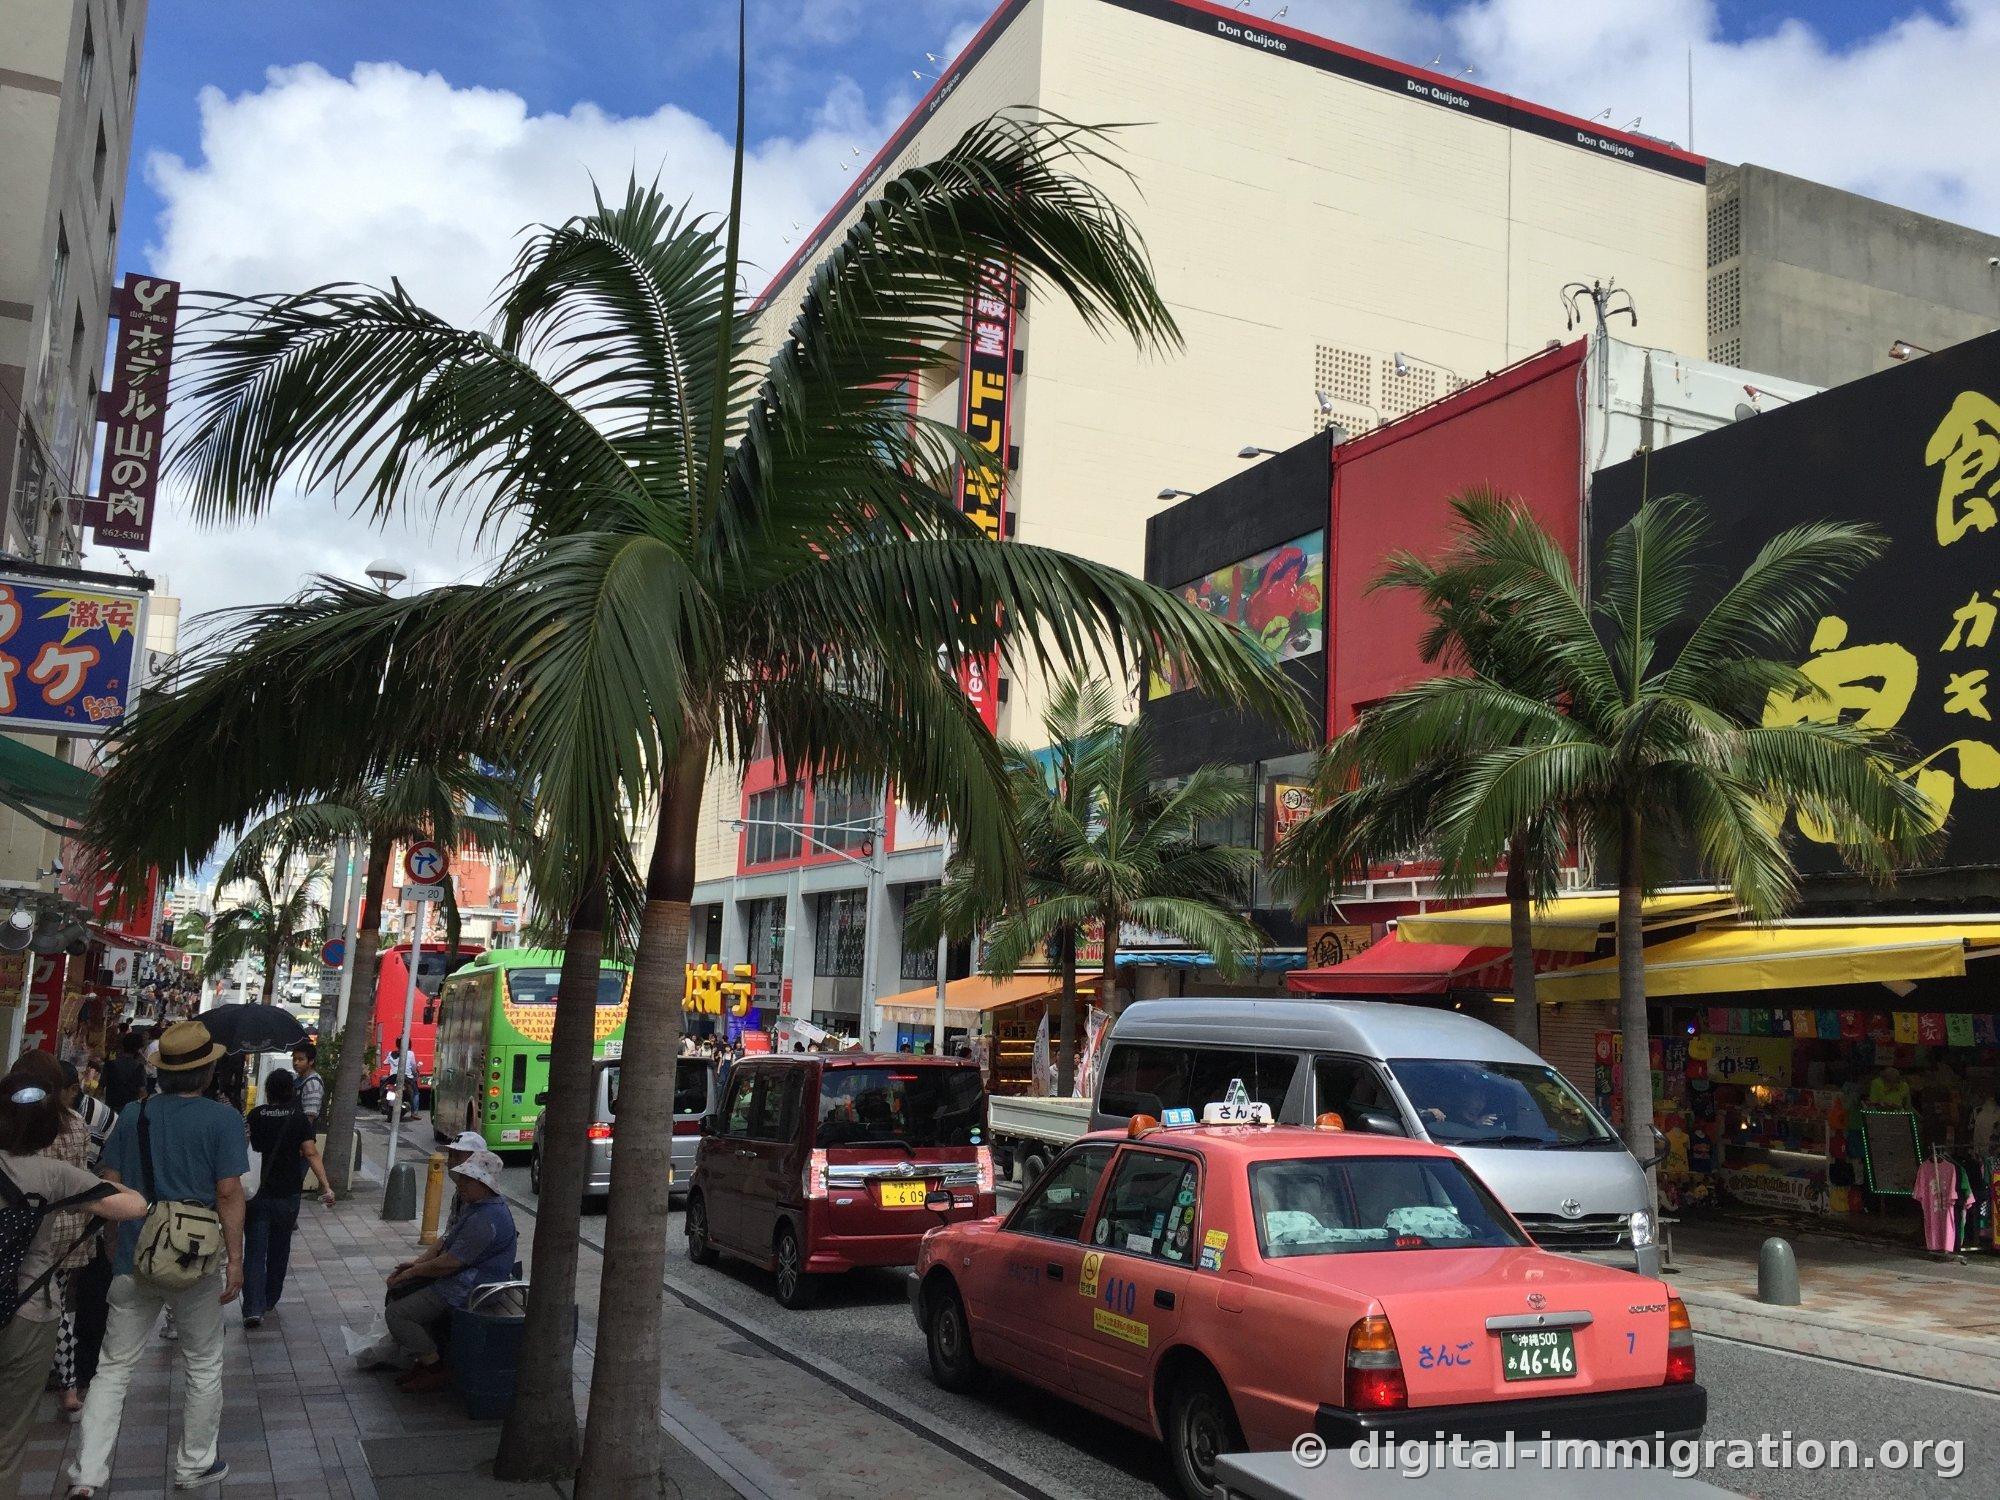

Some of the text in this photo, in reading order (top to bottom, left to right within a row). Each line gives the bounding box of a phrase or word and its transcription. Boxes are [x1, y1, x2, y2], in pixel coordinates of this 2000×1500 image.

[1216, 21, 1287, 51] Don Quijote
[1406, 79, 1470, 109] Don Quijote
[1576, 131, 1635, 159] Don Quijote
[102, 528, 145, 541] 862-5301
[69, 600, 134, 628] 激安
[1105, 1277, 1136, 1315] 410
[1518, 1332, 1558, 1347] 沖縄500
[1626, 1332, 1635, 1355] 7
[1418, 1341, 1474, 1370] さんご
[1519, 1346, 1573, 1375] 46-46
